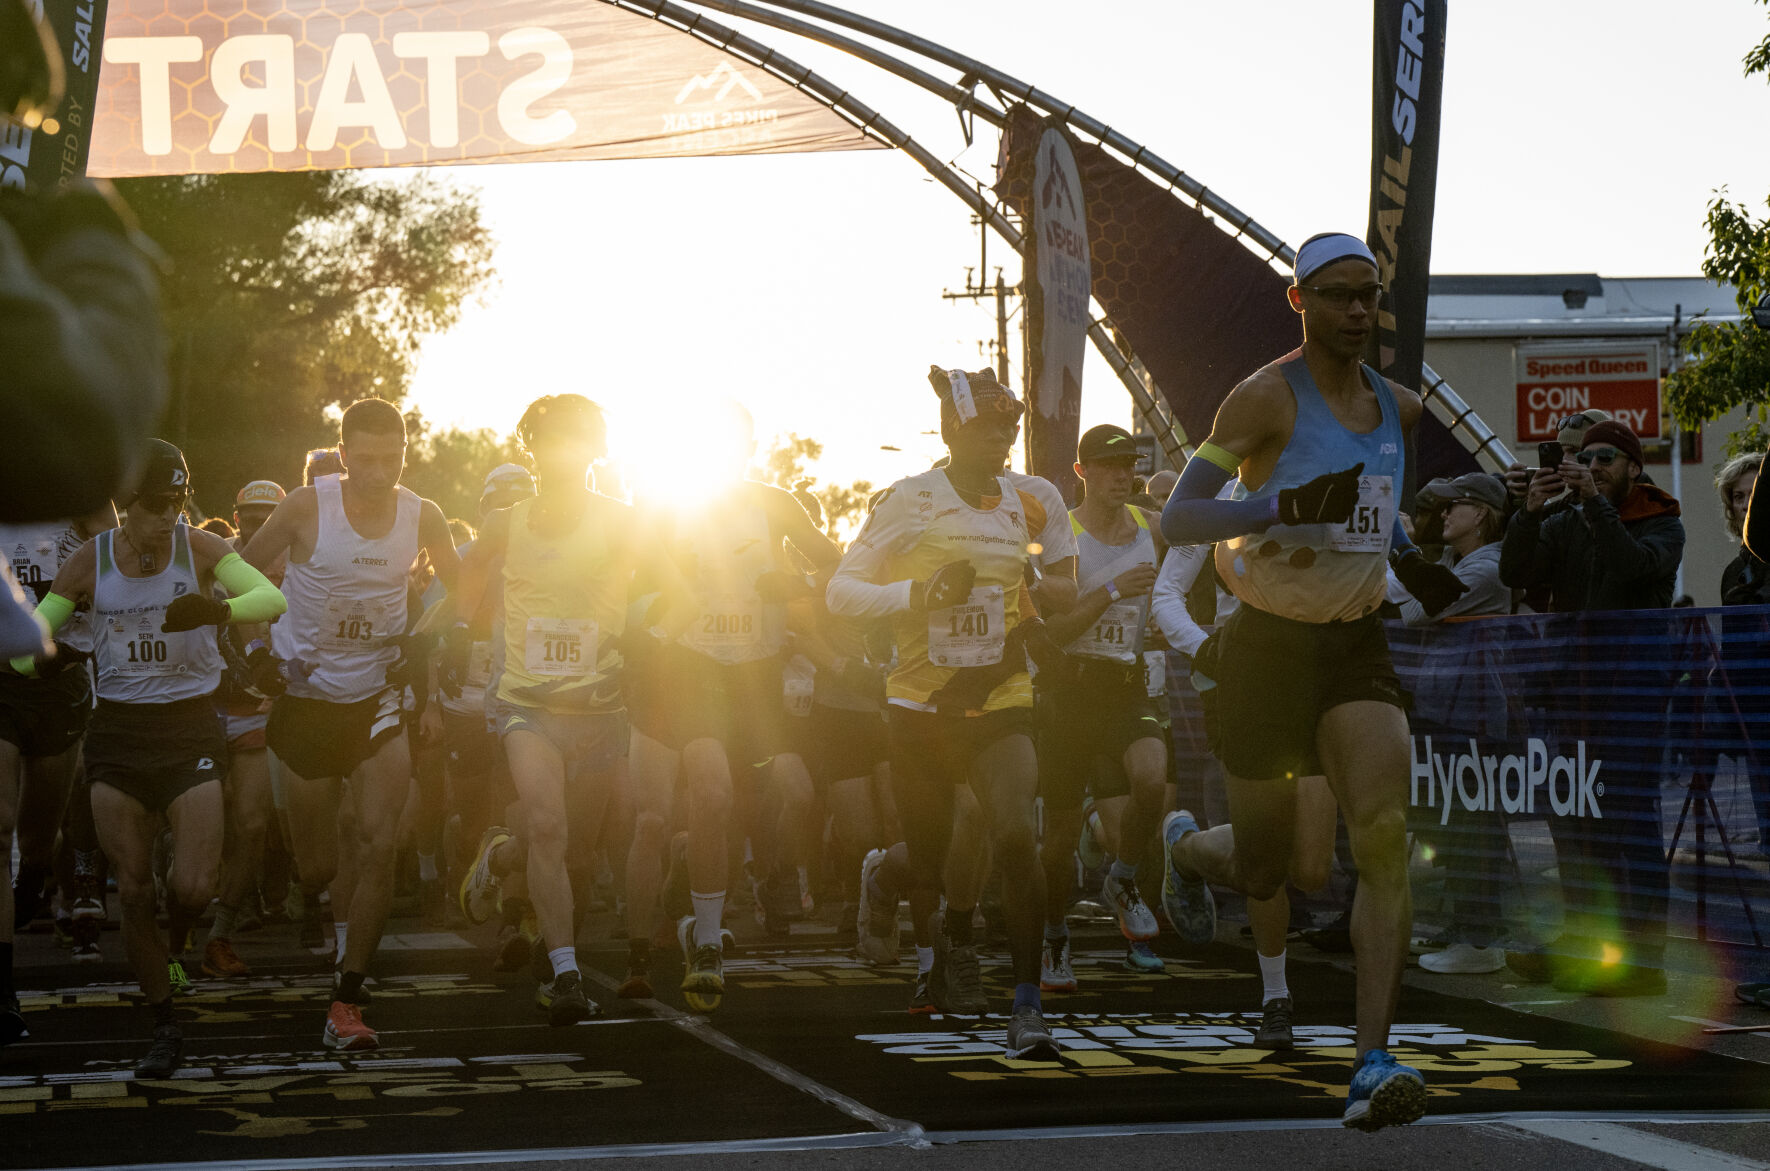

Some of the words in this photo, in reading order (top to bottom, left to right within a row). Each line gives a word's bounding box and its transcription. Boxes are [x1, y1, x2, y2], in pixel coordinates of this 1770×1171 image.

[72, 0, 95, 73] SAL
[1392, 0, 1425, 146] SER
[1526, 359, 1586, 378] Speed
[1589, 359, 1648, 375] Queen
[1527, 386, 1590, 410] COIN
[1528, 408, 1648, 435] LARY
[1346, 506, 1380, 534] 151
[360, 557, 389, 567] TERREX
[335, 620, 373, 641] 103
[947, 612, 989, 638] 140
[1094, 625, 1124, 644] 141
[127, 640, 167, 663] 100
[543, 640, 582, 663] 105
